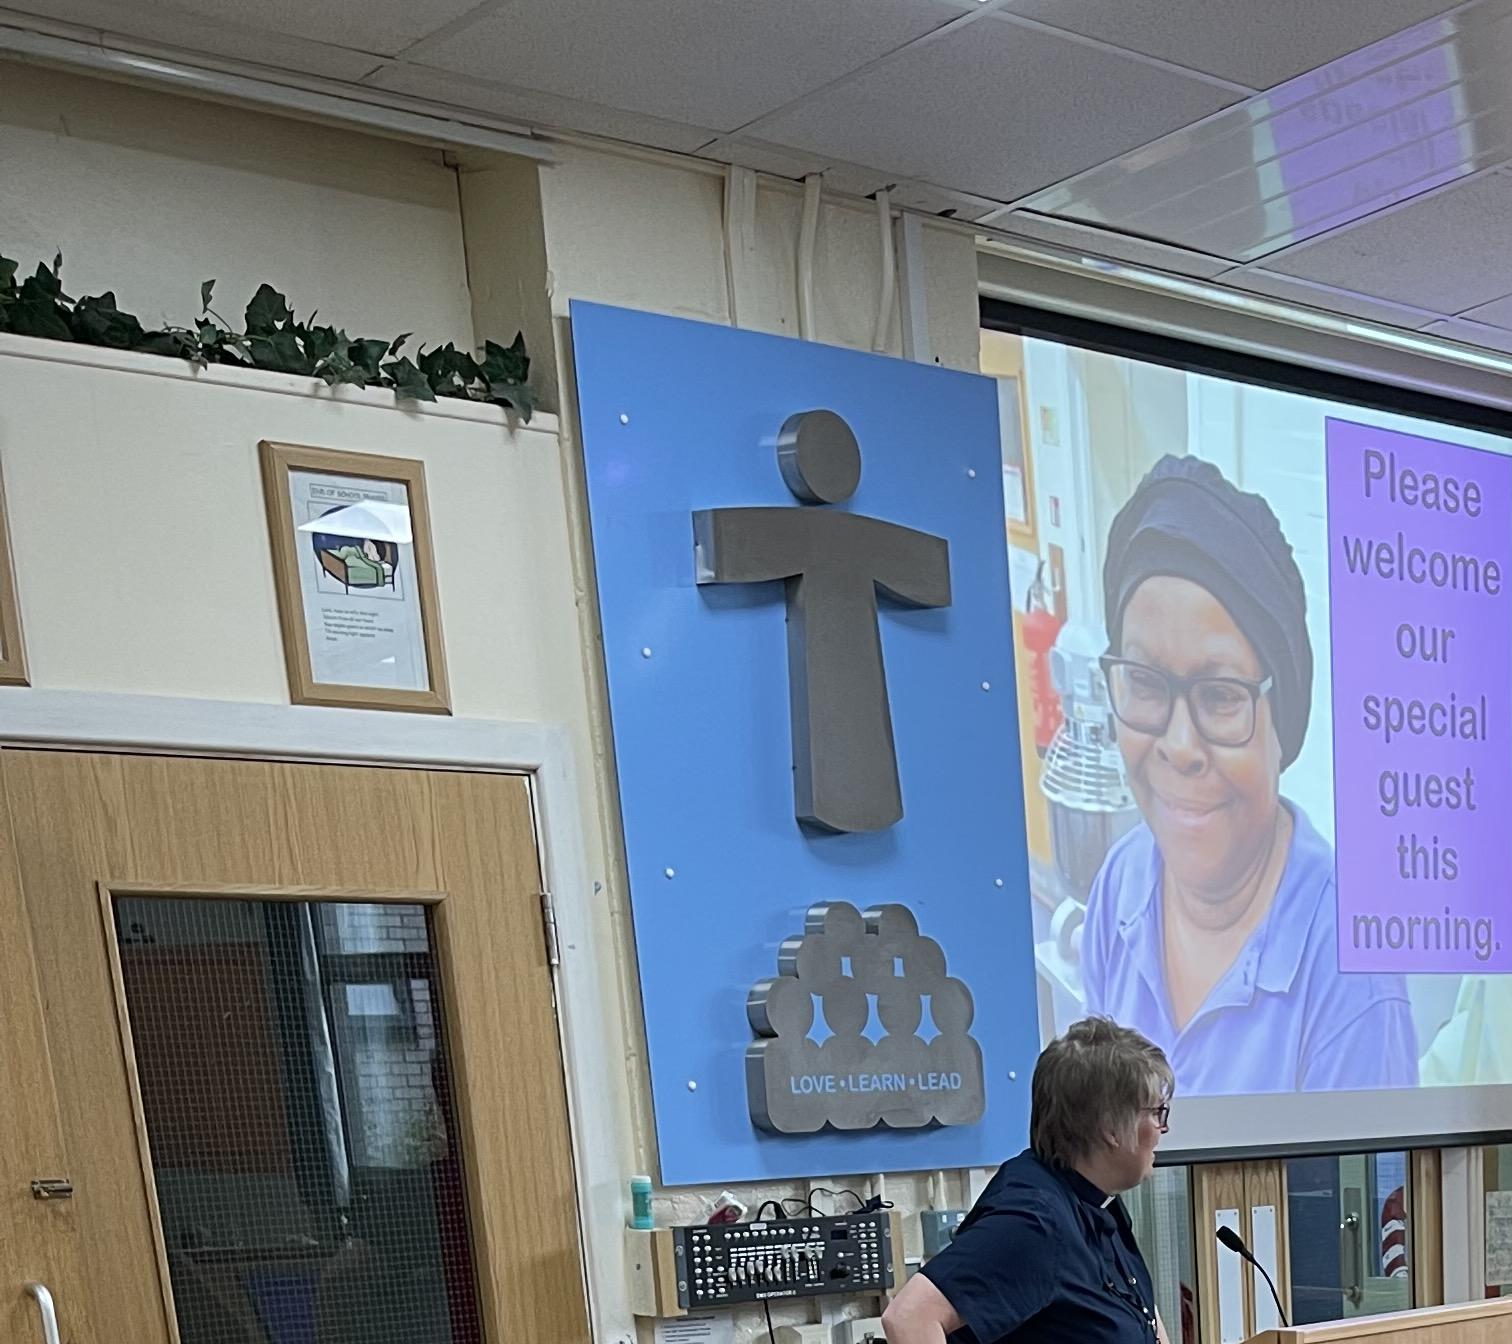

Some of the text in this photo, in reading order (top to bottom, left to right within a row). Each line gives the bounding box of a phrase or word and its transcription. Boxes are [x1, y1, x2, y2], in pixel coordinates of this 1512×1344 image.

[1364, 449, 1481, 517] Please
[1343, 532, 1501, 595] welcome
[1396, 623, 1455, 663] our
[1363, 693, 1486, 743] special
[1378, 767, 1476, 817] guest
[1397, 834, 1459, 881] this
[1353, 906, 1500, 961] morning.
[790, 1072, 962, 1094] LOVE LEARN LEAD
